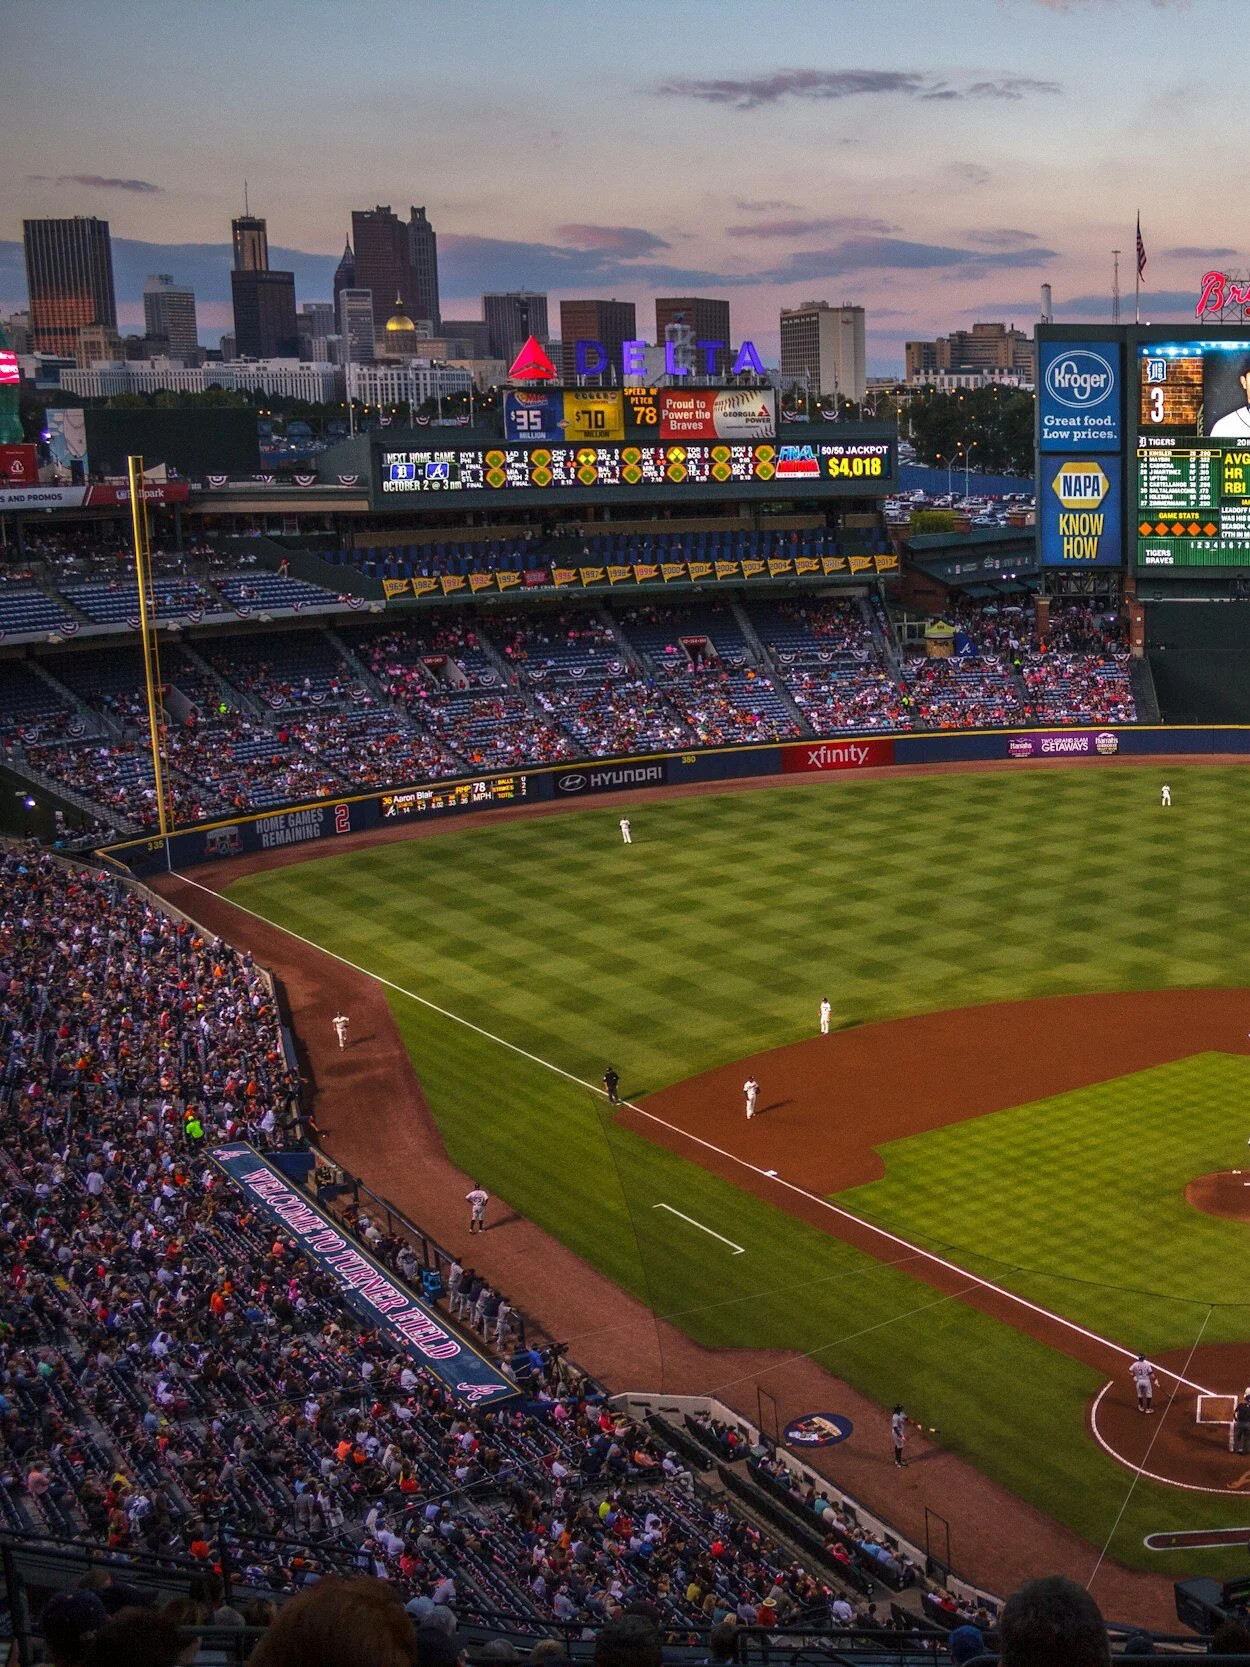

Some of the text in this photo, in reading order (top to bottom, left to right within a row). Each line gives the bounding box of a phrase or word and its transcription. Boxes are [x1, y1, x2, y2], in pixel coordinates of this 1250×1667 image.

[576, 340, 766, 375] DELTA
[1054, 361, 1107, 399] Kroger
[624, 388, 648, 396] SPEED
[630, 397, 653, 405] PITCH
[666, 399, 706, 409] Proud to
[1150, 387, 1164, 422] 3
[633, 407, 657, 424] 78
[662, 410, 710, 420] Power the
[670, 421, 703, 430] Braves
[1044, 416, 1116, 426] Great food.
[1043, 429, 1117, 441] Low prices.
[822, 446, 888, 455] 50/50 JACKPOT
[387, 452, 455, 464] NEXT HOME GAME
[1224, 454, 1250, 464] AVG
[829, 457, 881, 477] $4,018
[1225, 468, 1243, 479] HR
[383, 481, 420, 492] OCTOBER
[423, 480, 429, 490] 2
[1062, 476, 1101, 497] NAPA
[1225, 482, 1246, 493] RBI
[8, 494, 25, 502] AND
[28, 493, 62, 501] PROMOS
[1059, 513, 1103, 536] KNOW
[1064, 537, 1098, 559] HOW
[609, 568, 626, 578] 1998
[637, 567, 654, 576] 1999
[663, 566, 681, 574] 2000
[690, 565, 708, 574] 2001
[716, 564, 734, 572] 2002
[471, 576, 489, 585] 1992
[582, 571, 600, 579] 1997
[414, 580, 432, 589] 1982
[1041, 742, 1088, 752] GETAWAYS
[681, 756, 696, 764] 380
[807, 745, 868, 768] xfinity
[591, 766, 662, 787] HYUNDAI
[473, 782, 486, 793] 78
[393, 785, 471, 803] Aaron Blair RHP
[473, 792, 491, 801] MPH
[256, 809, 324, 834] HOME GAMES
[335, 804, 350, 833] 2
[262, 823, 321, 848] REMAINING
[148, 840, 164, 851] 335
[241, 1167, 461, 1359] WELCOME TO TURNER FIELD
